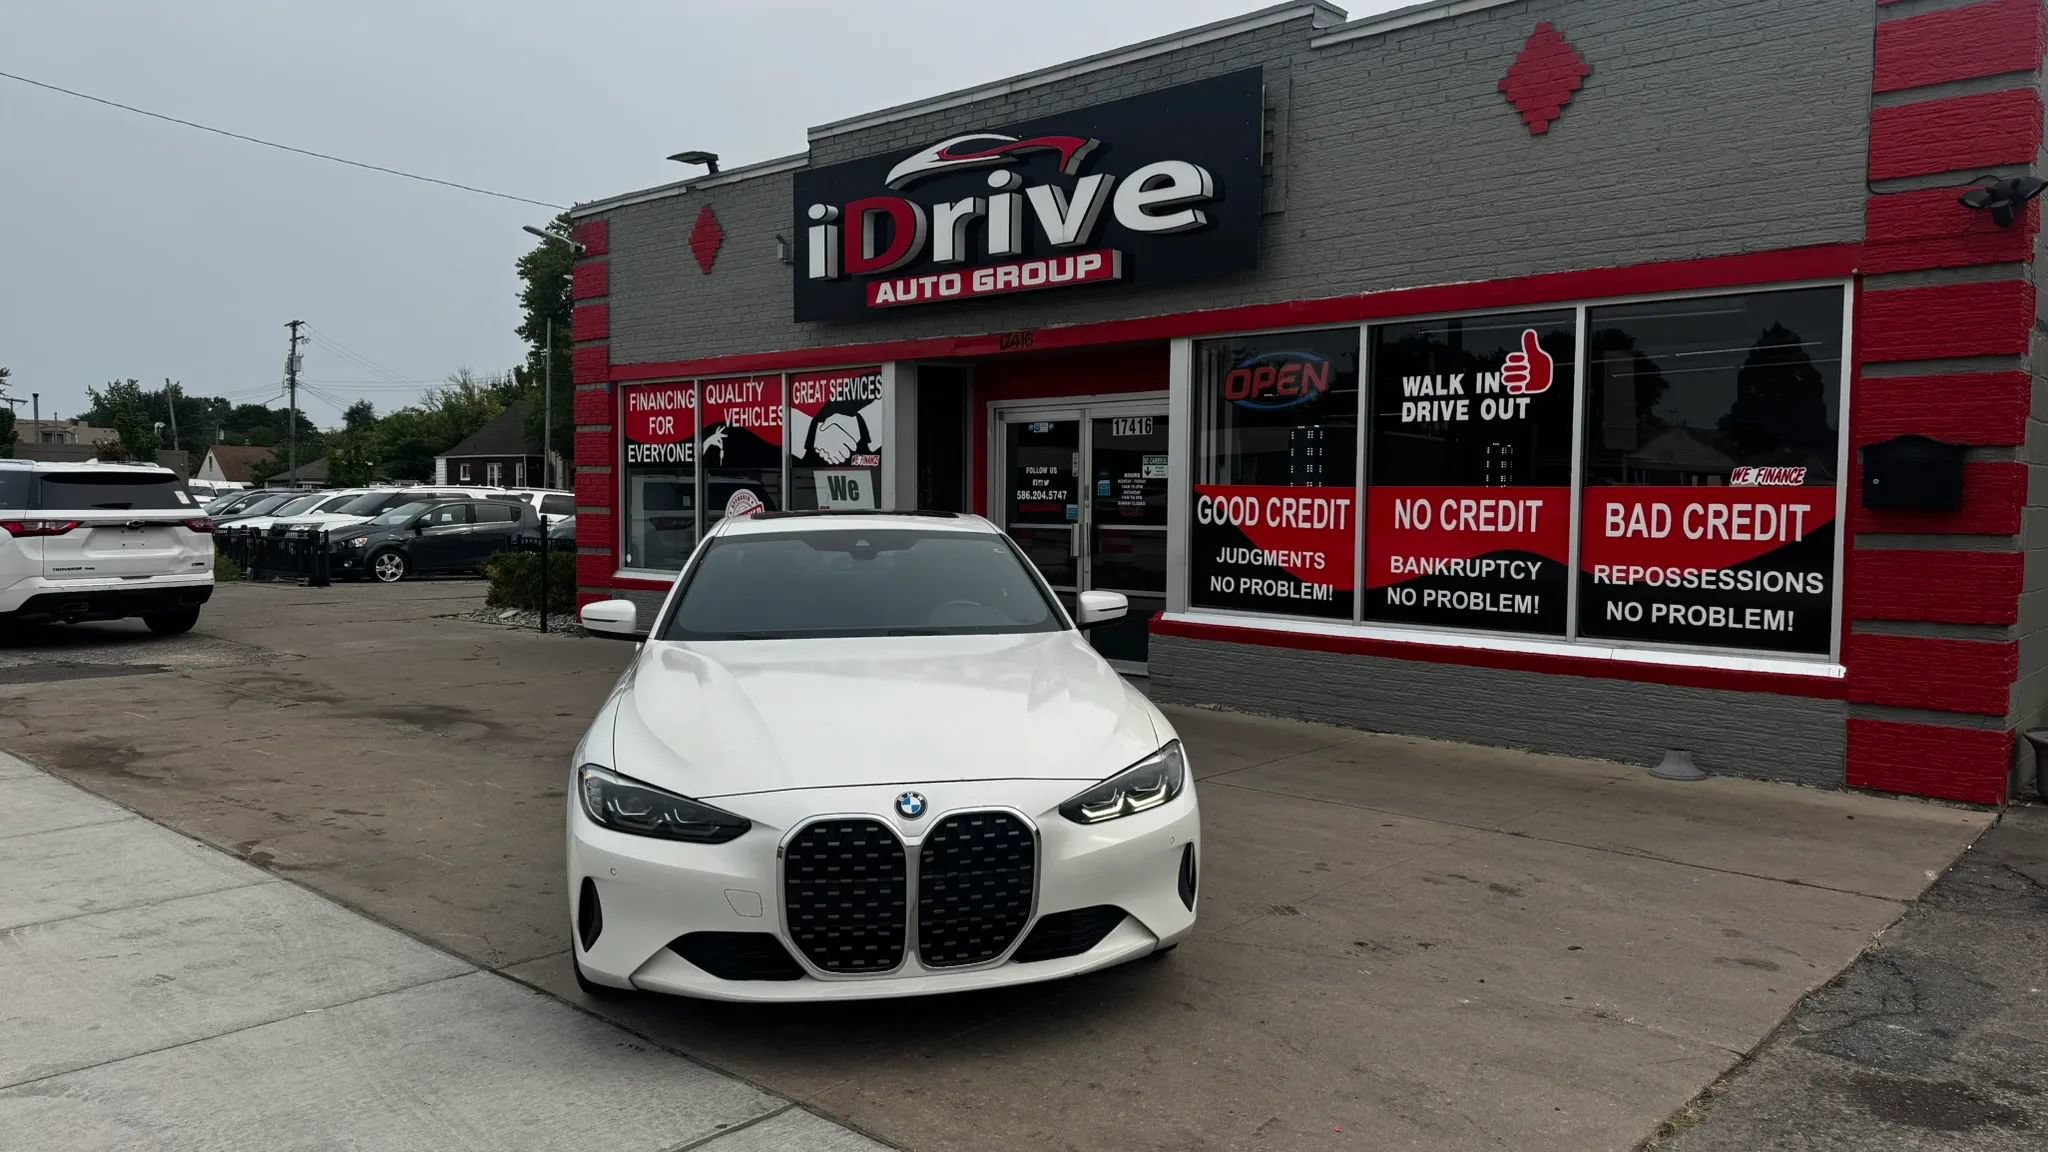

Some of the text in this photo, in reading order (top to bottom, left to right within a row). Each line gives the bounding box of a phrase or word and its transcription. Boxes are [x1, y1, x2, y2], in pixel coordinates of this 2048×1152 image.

[807, 160, 1214, 280] iDrive
[875, 253, 1102, 305] AUTO GROUP
[706, 381, 764, 405] QUALITY
[792, 375, 882, 404] GREAT SERVICES
[1225, 361, 1329, 400] OPEN
[1402, 372, 1500, 397] WALK IN
[629, 389, 695, 412] FINANCING
[1402, 397, 1531, 423] DRIVE OUT
[649, 416, 674, 435] FOR
[724, 407, 783, 428] VEHICLES
[1114, 418, 1152, 435] 17416
[1026, 466, 1057, 475] FOLLOW US
[1731, 466, 1806, 484] WE FINANCE
[827, 475, 860, 502] We
[1017, 490, 1067, 500] 586.204.5747
[1197, 495, 1350, 530] GOOD CREDIT
[1394, 499, 1543, 532] NO CREDIT
[1605, 502, 1811, 542] BAD CREDIT
[1216, 547, 1325, 570] JUDGMENTS
[1390, 556, 1542, 581] BANKRUPTCY
[1210, 576, 1334, 601] NO PROBLEM!
[1594, 564, 1824, 594] REPOSSESSIONS
[1387, 587, 1540, 615] NO PROBLEM!
[1606, 600, 1795, 632] NO PROBLEM!
